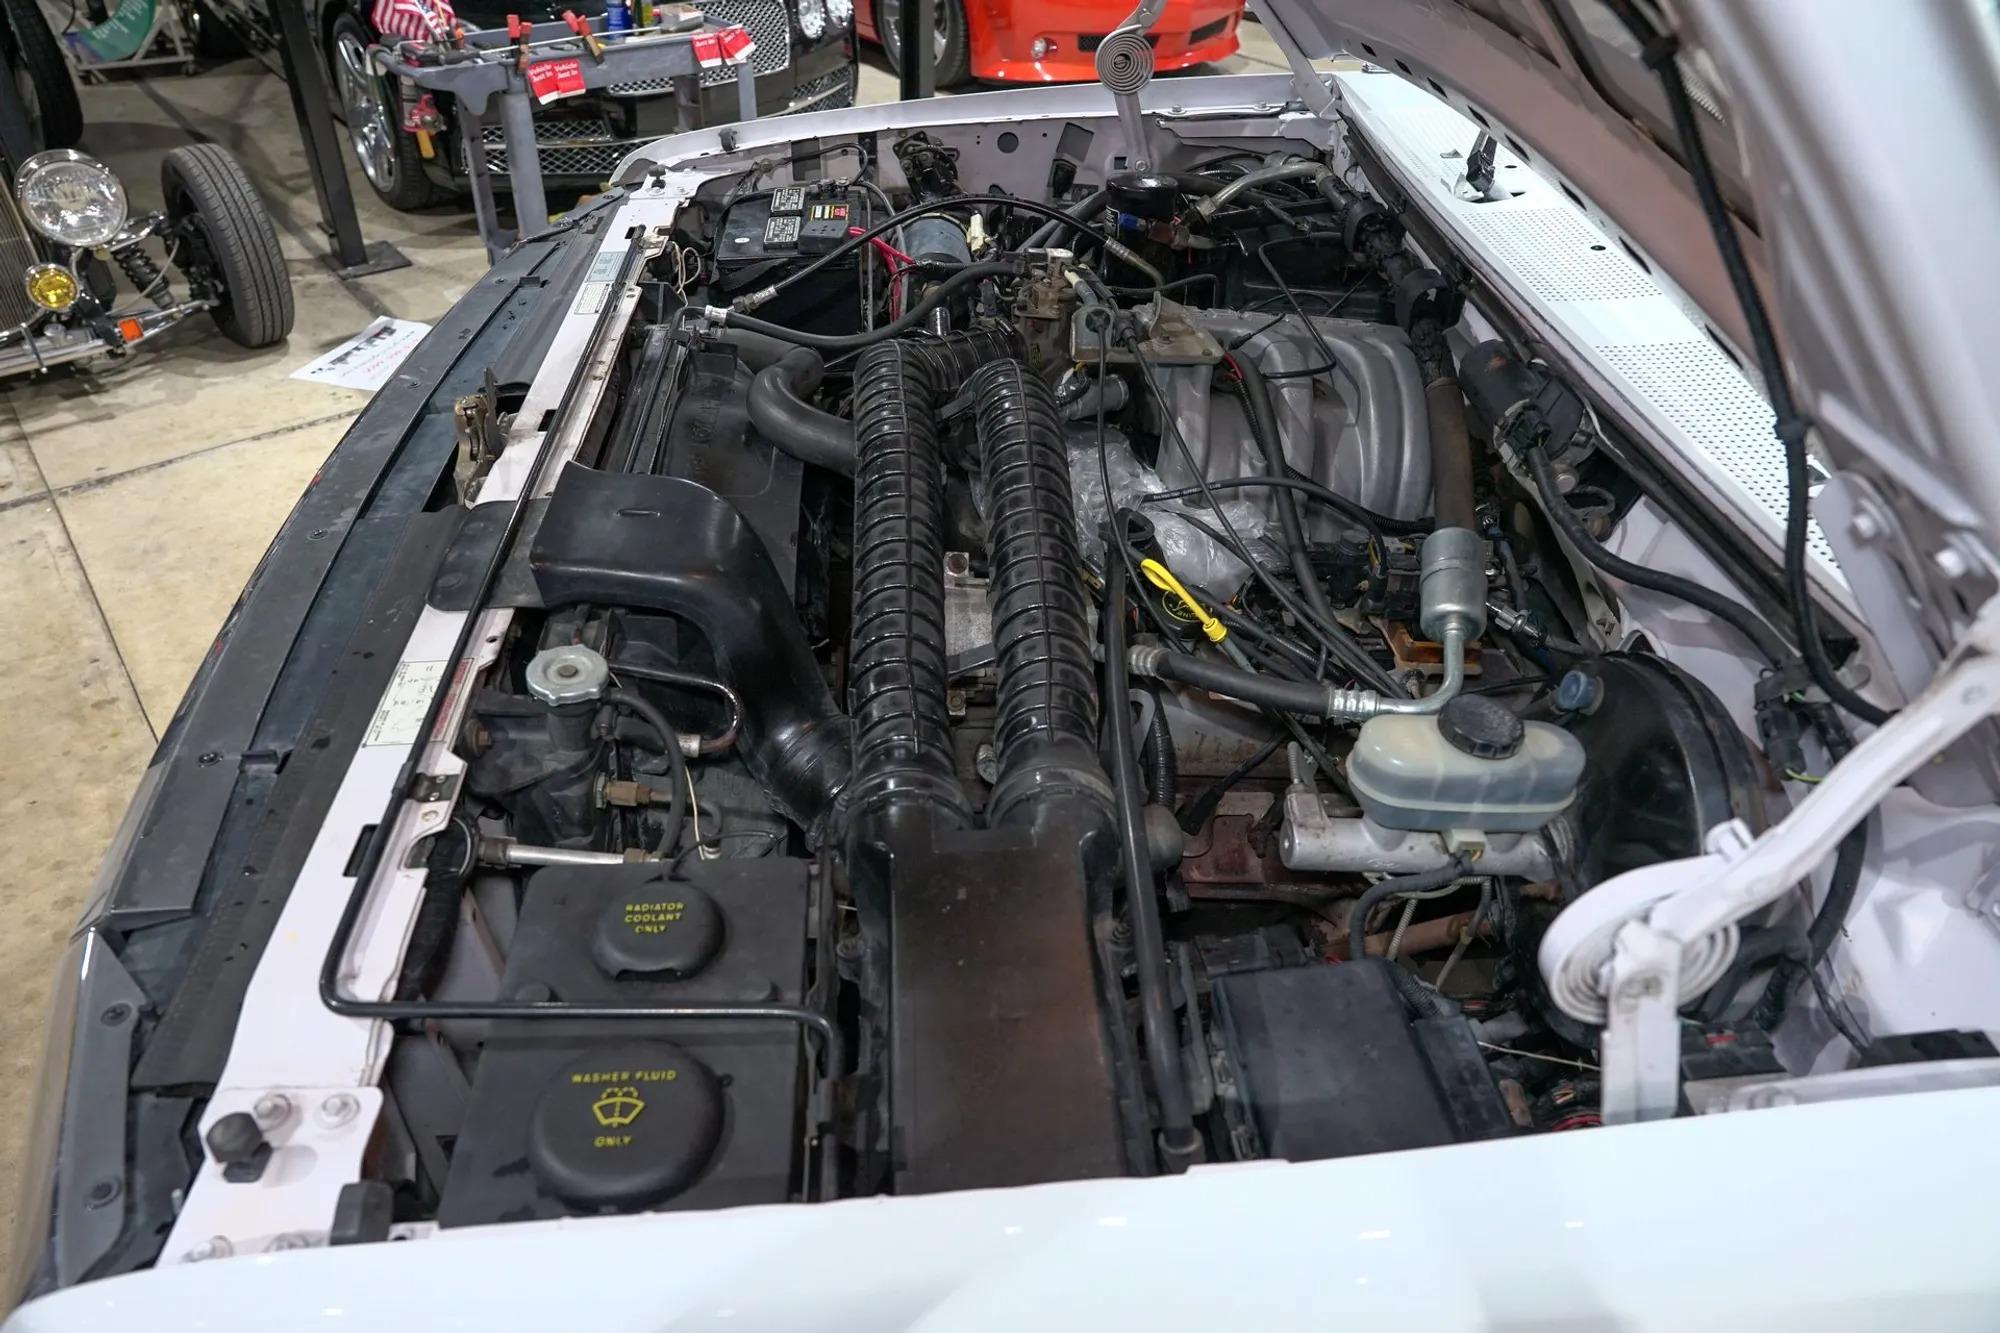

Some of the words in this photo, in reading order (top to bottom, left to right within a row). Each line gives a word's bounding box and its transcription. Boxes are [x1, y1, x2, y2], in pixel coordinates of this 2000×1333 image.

[625, 902, 684, 911] RADIATOR
[624, 913, 681, 923] COOLANT
[635, 925, 665, 933] ONLY
[571, 1072, 630, 1082] WASHER
[635, 1070, 676, 1080] FLUID
[594, 1136, 632, 1147] ONLY
